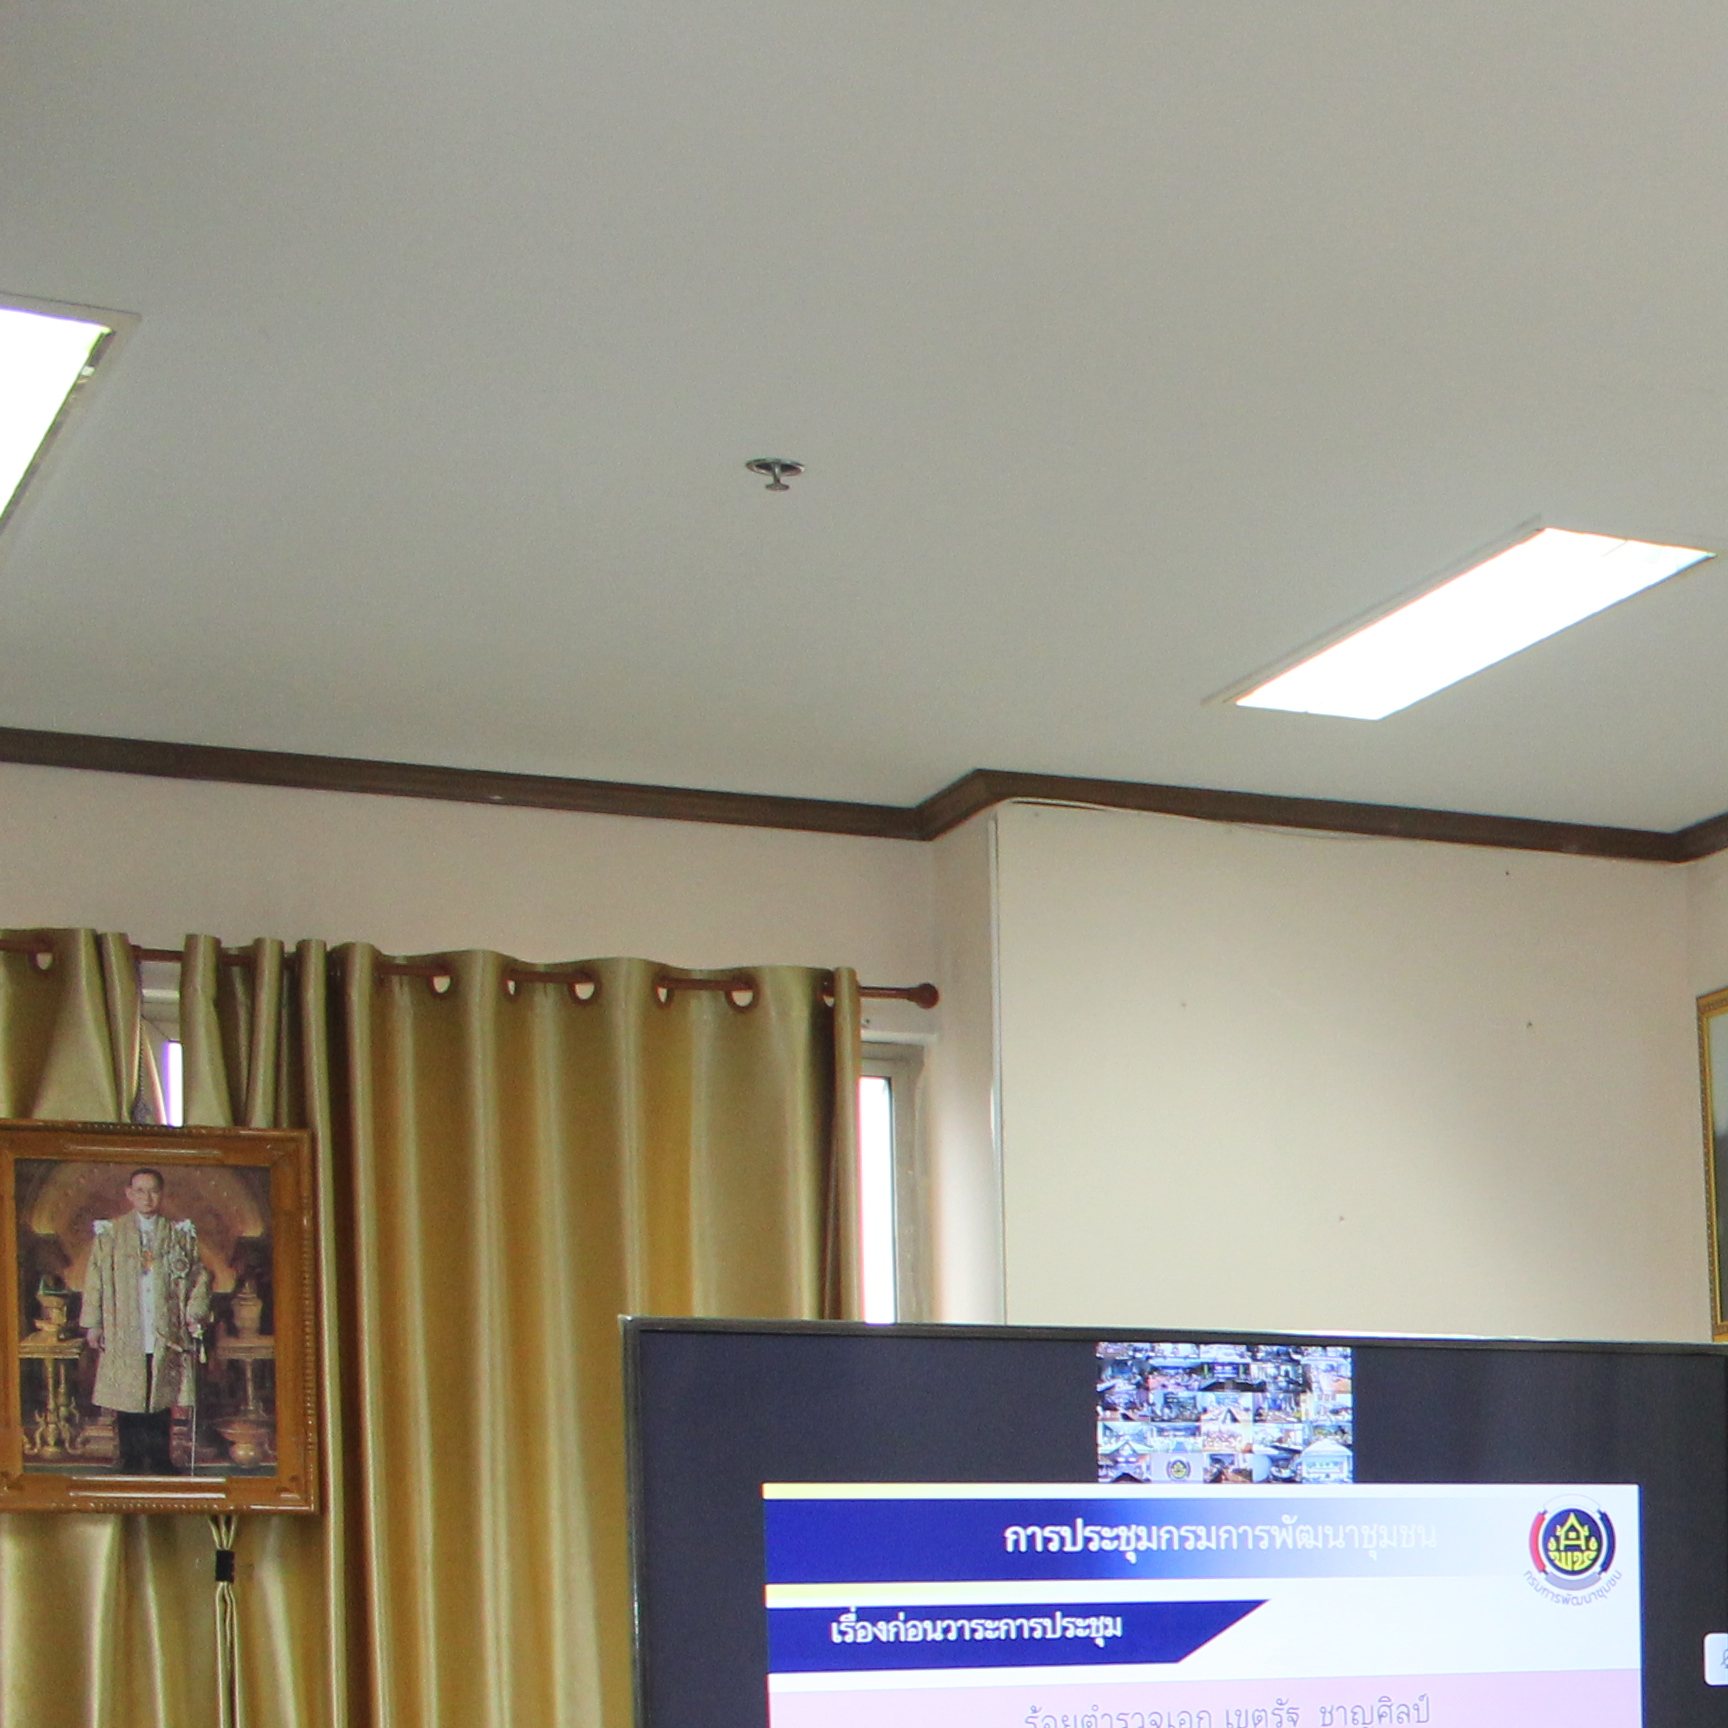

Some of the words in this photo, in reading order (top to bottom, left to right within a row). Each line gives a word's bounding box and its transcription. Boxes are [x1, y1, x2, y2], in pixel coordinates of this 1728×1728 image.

[1004, 1514, 1437, 1563] การประชุมกรมการพัฒนาชุมชน
[830, 1606, 1123, 1647] เรื่องก่อนวาระการประชุม
